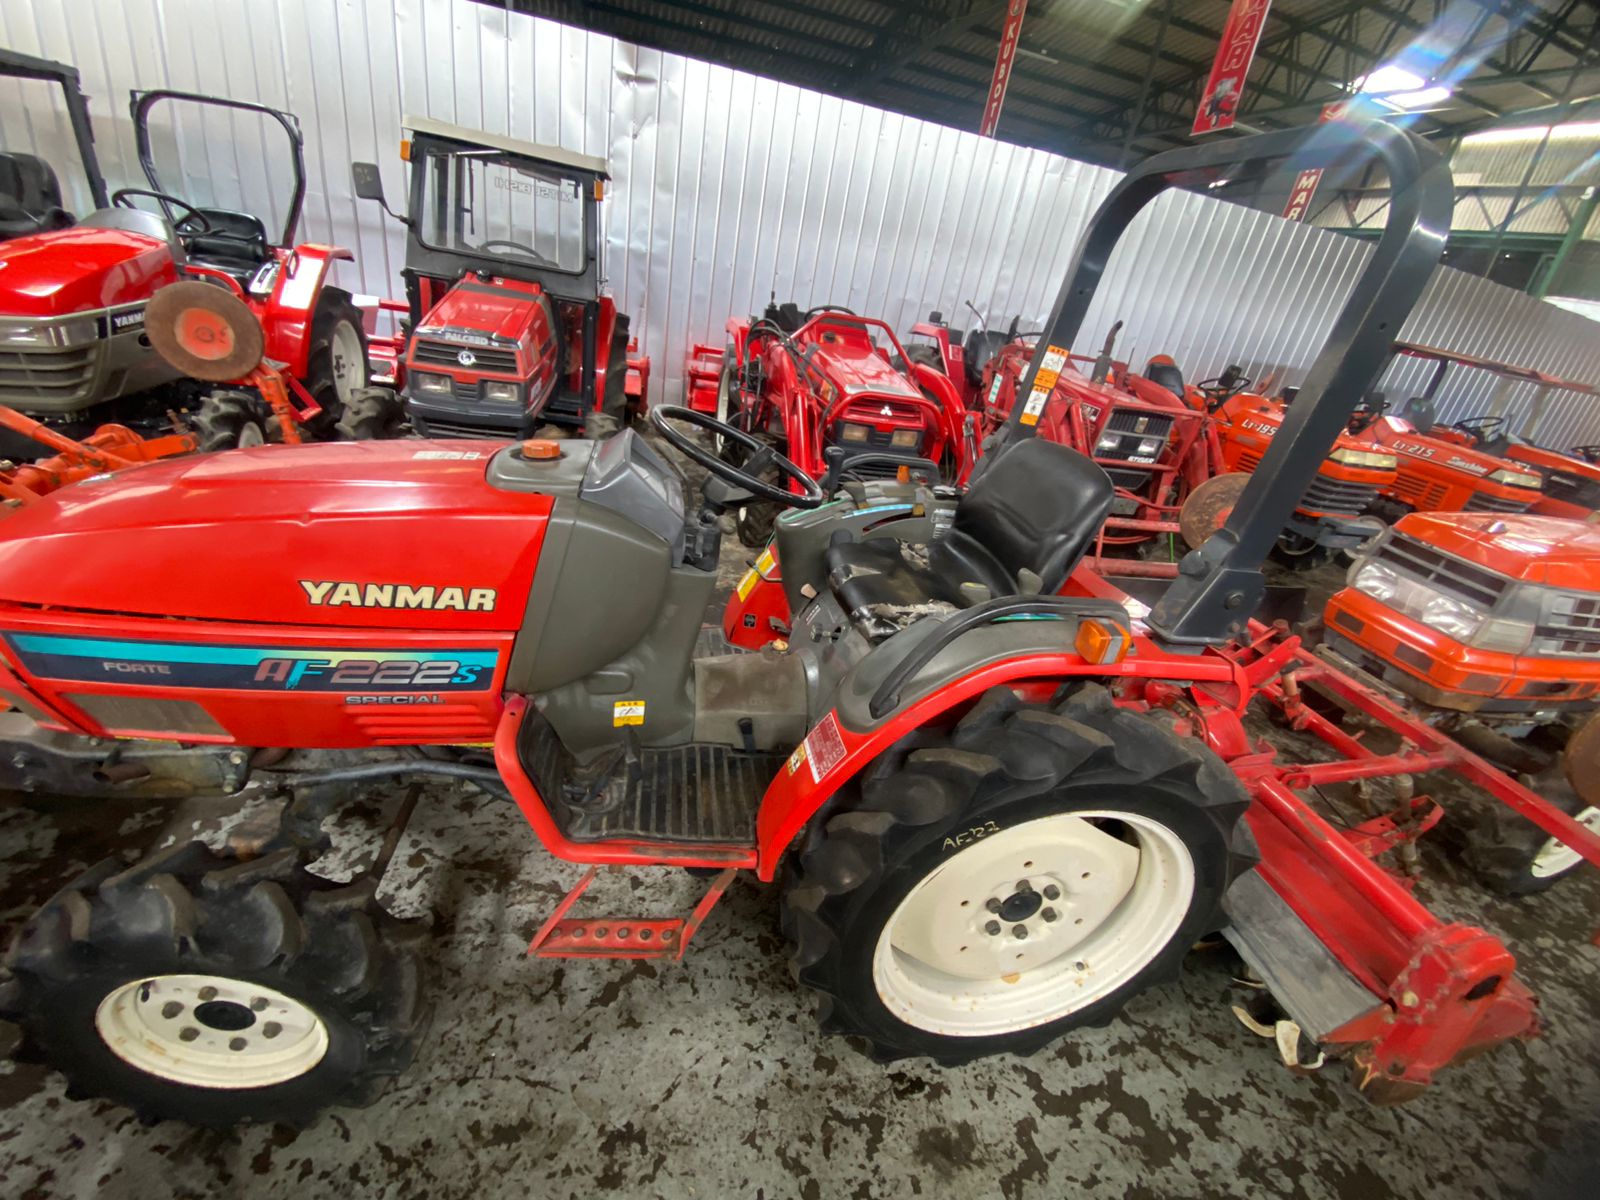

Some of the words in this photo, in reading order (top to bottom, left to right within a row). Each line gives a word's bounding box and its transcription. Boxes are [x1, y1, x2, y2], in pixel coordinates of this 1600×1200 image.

[985, 22, 1017, 136] KUBOTA
[1287, 172, 1317, 220] MAR
[300, 580, 496, 612] YANMAR
[102, 661, 171, 675] FORTE
[345, 695, 444, 705] SPECIAL
